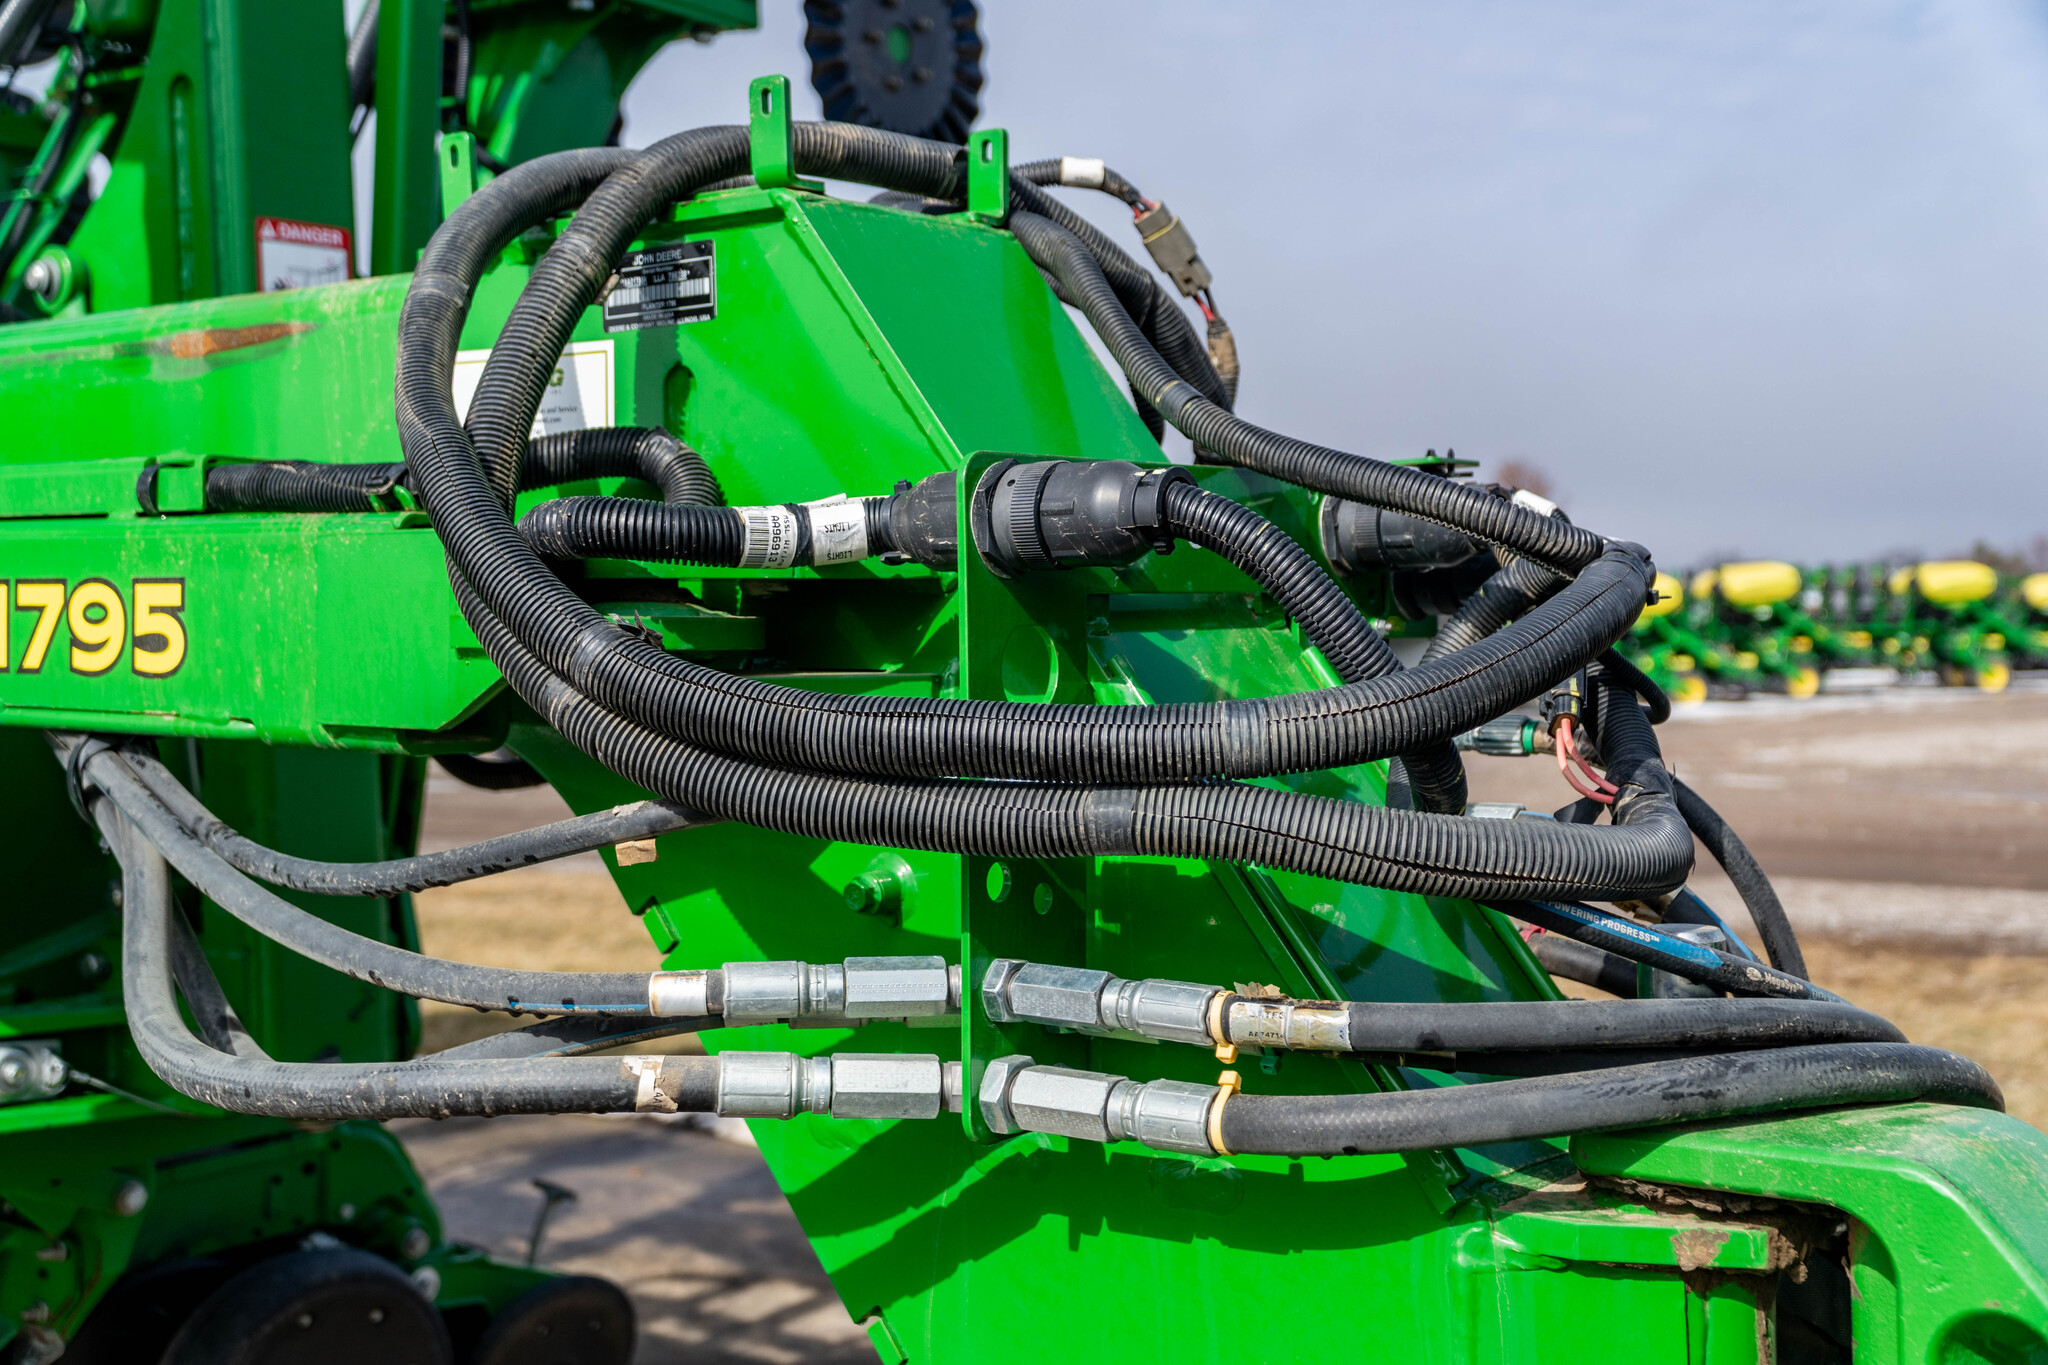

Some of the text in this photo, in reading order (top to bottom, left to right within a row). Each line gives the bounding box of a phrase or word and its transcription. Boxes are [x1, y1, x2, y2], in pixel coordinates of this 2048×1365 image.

[277, 221, 343, 245] DANGER
[632, 249, 682, 266] JOHN DEERE
[609, 325, 626, 333] DEERE
[631, 321, 656, 331] COMPANY
[824, 521, 850, 533] LIGHTS
[768, 515, 782, 563] AA96913
[827, 550, 853, 561] LIGHTS
[1549, 901, 1600, 924] POWERING
